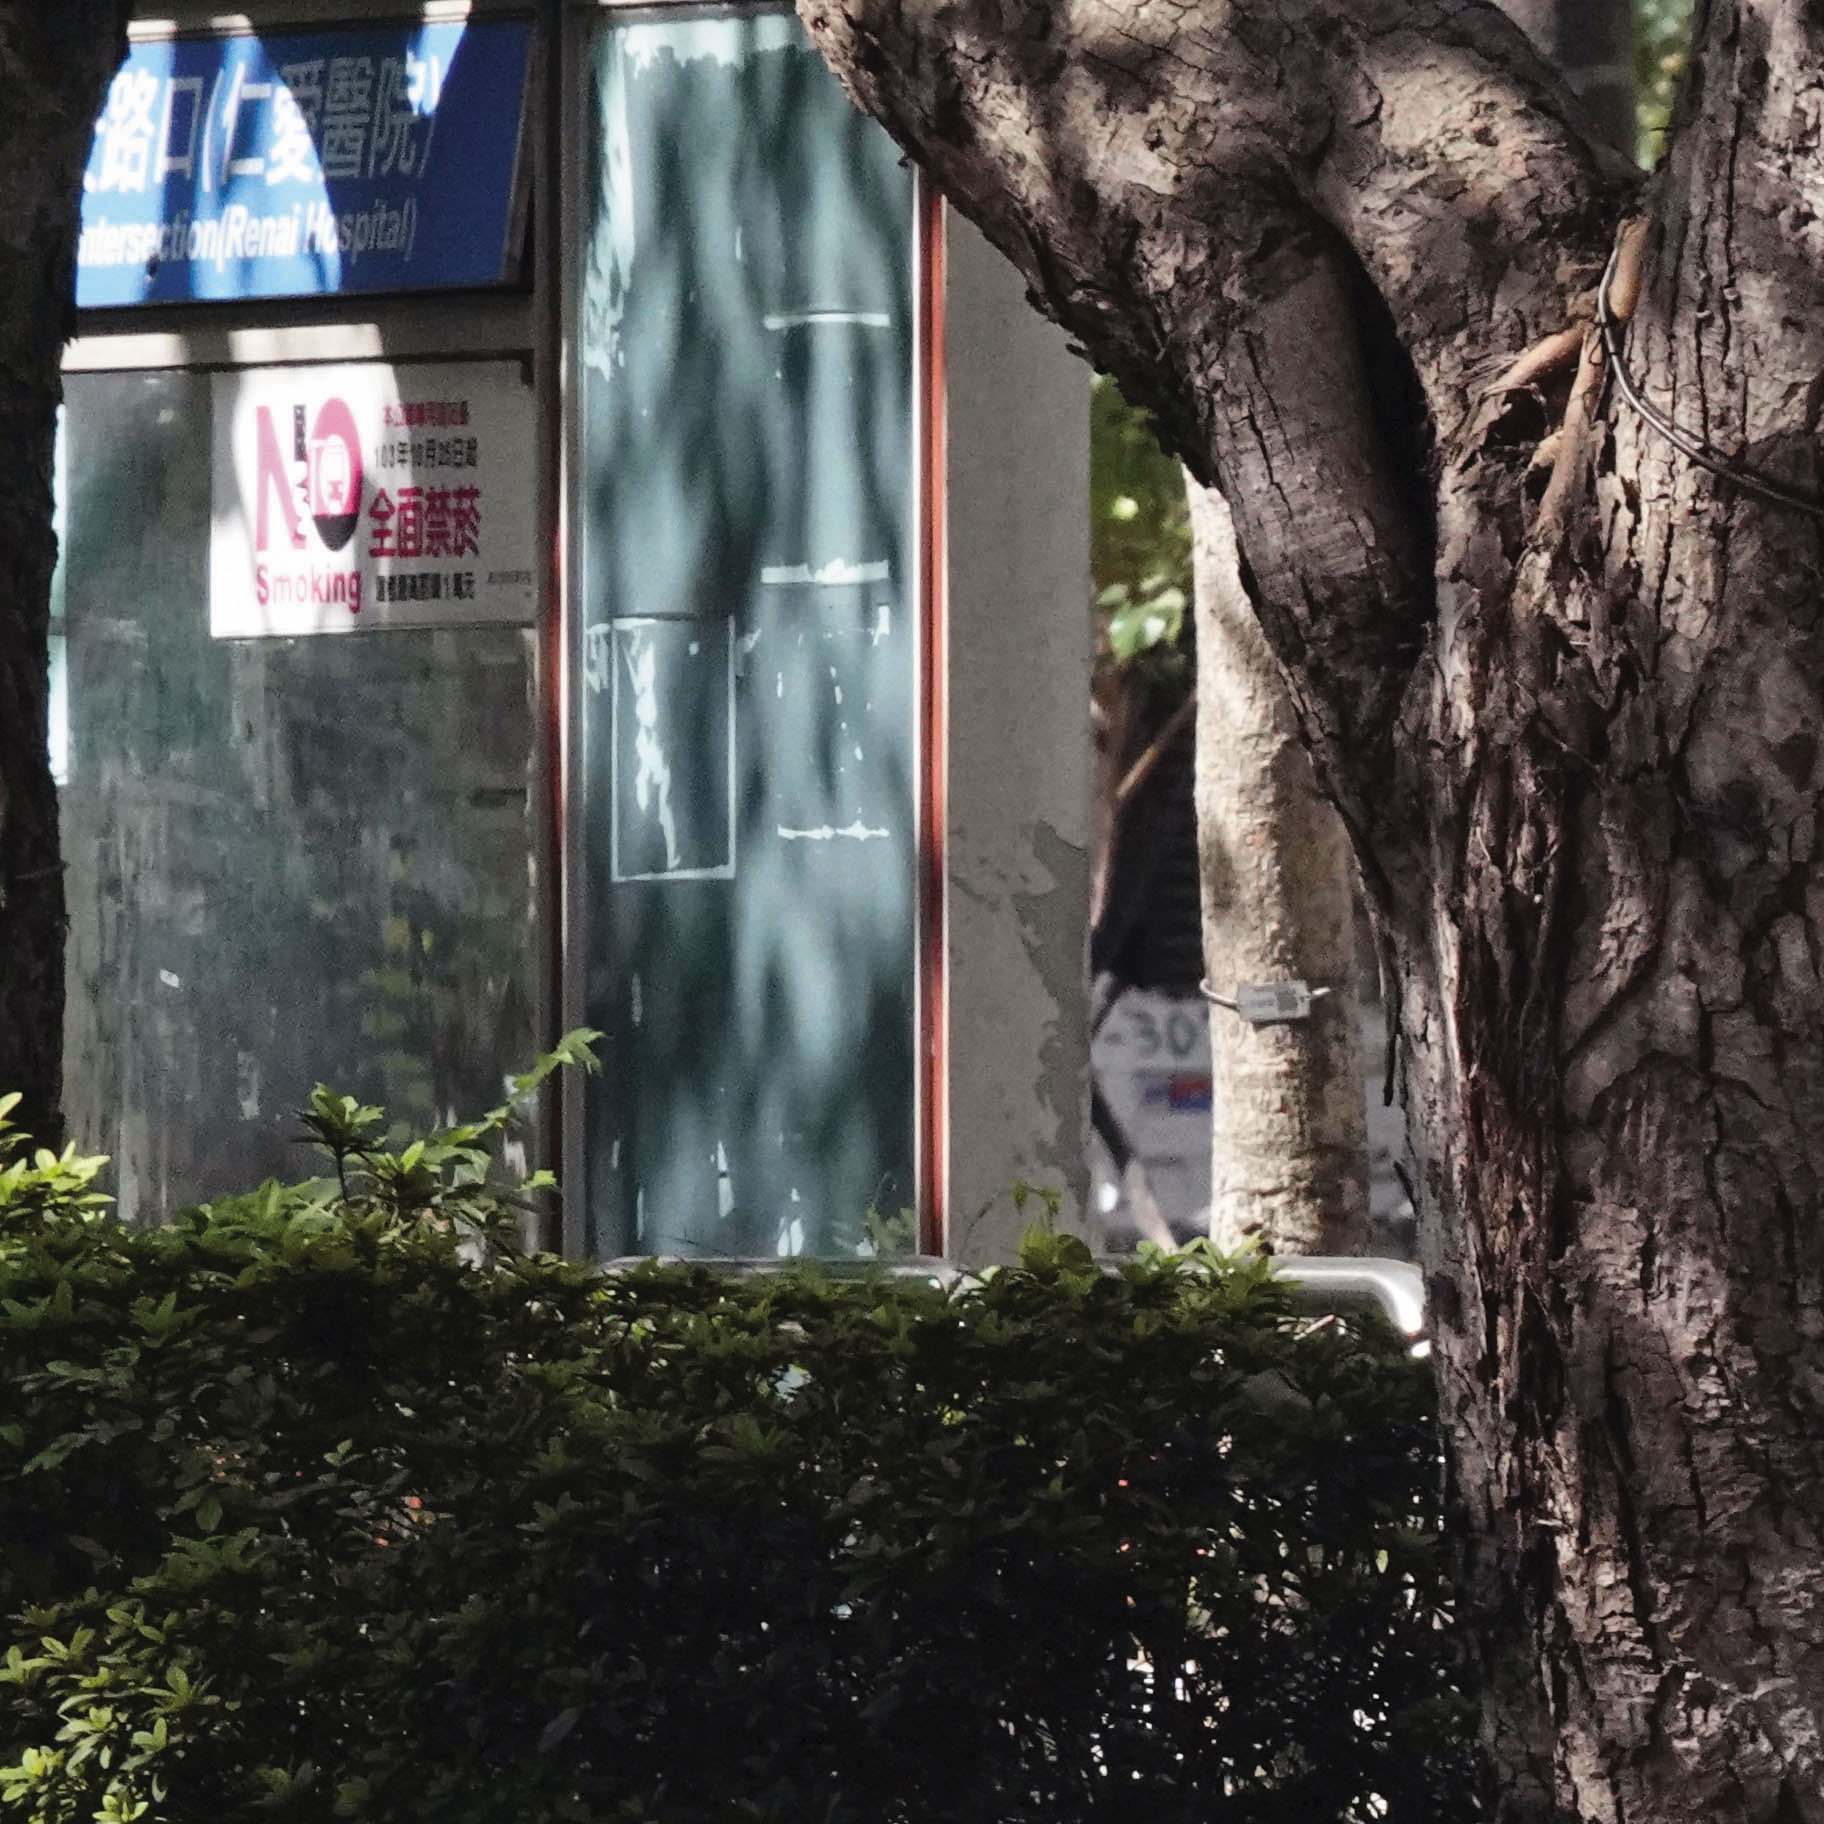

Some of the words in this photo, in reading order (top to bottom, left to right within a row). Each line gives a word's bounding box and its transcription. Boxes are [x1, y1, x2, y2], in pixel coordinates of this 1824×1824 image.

[85, 54, 439, 193] 路口(仁愛醫院)
[256, 397, 363, 551] NO
[256, 563, 361, 613] Smoking
